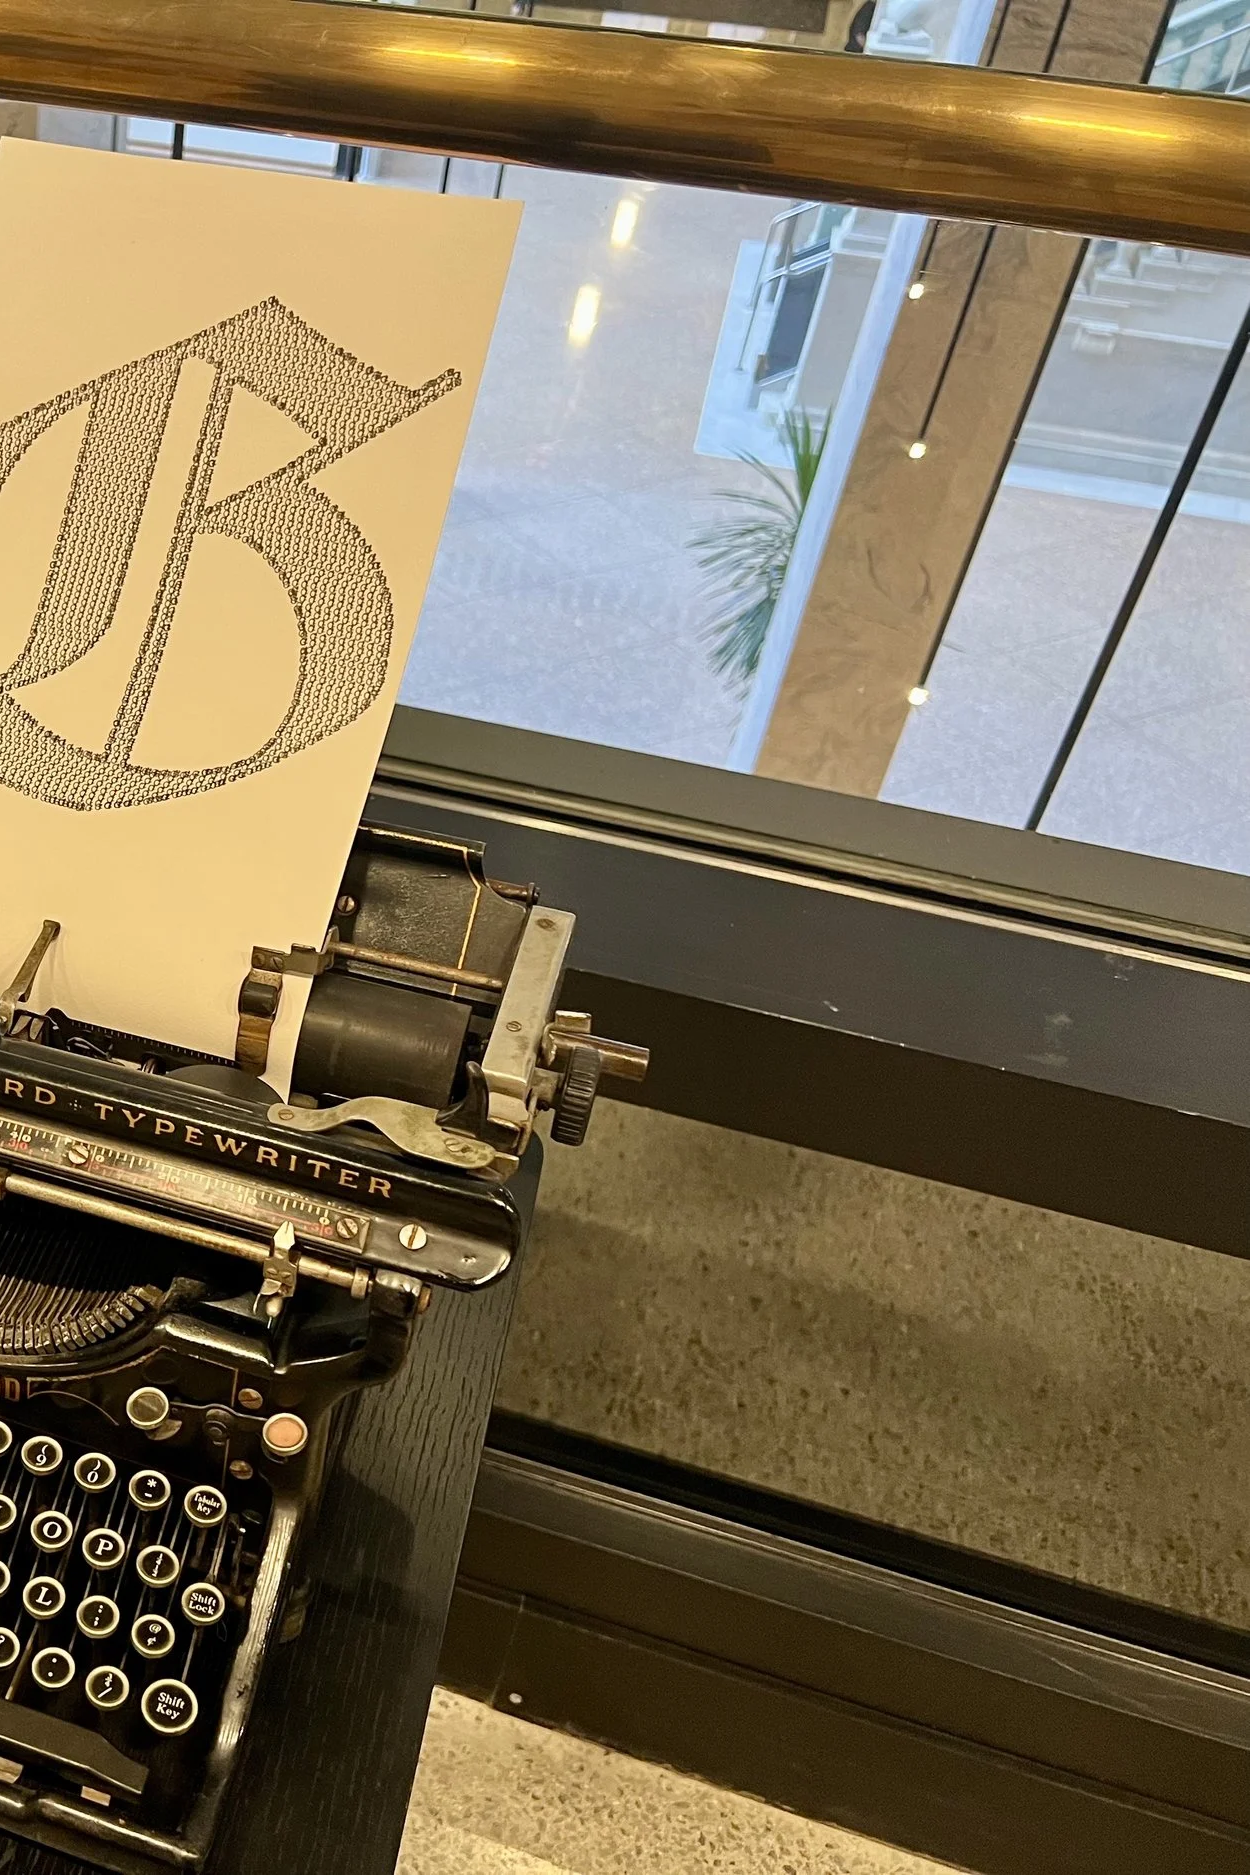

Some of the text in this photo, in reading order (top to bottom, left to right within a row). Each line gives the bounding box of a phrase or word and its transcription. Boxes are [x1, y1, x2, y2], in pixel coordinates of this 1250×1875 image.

[10, 1131, 32, 1143] 40
[94, 1102, 392, 1199] TYPEWRITER
[36, 1454, 47, 1466] 9
[197, 1502, 212, 1516] Key
[42, 1522, 61, 1539] O
[94, 1539, 114, 1556] P
[35, 1587, 53, 1606] L
[191, 1592, 217, 1607] Shift
[189, 1600, 215, 1615] Lock
[157, 1691, 185, 1710] Shift
[155, 1702, 181, 1720] Key
